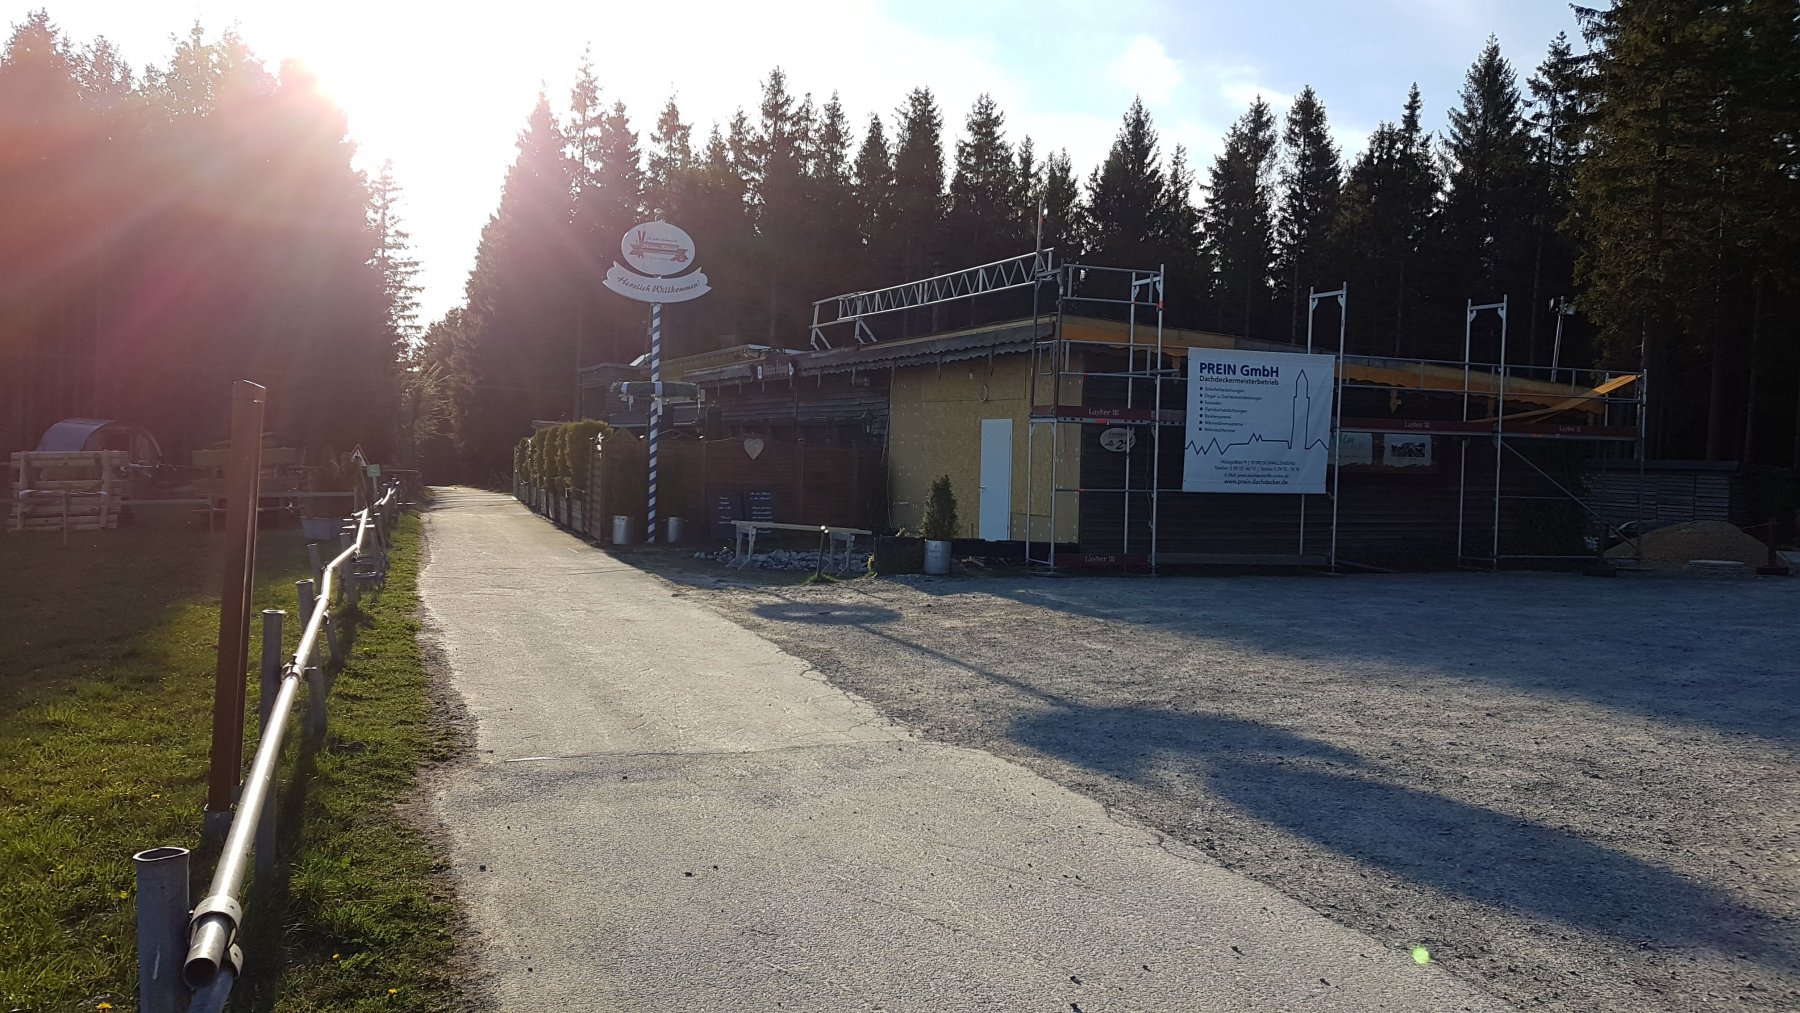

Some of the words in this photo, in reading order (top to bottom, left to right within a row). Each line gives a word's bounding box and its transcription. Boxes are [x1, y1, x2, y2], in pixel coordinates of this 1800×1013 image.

[617, 276, 650, 293] Herzlich
[652, 280, 701, 294] Willkommen!
[1199, 362, 1236, 376] PREIN
[1240, 364, 1280, 378] GmbH
[1199, 375, 1280, 386] Dachdeckermeisterbetrieb
